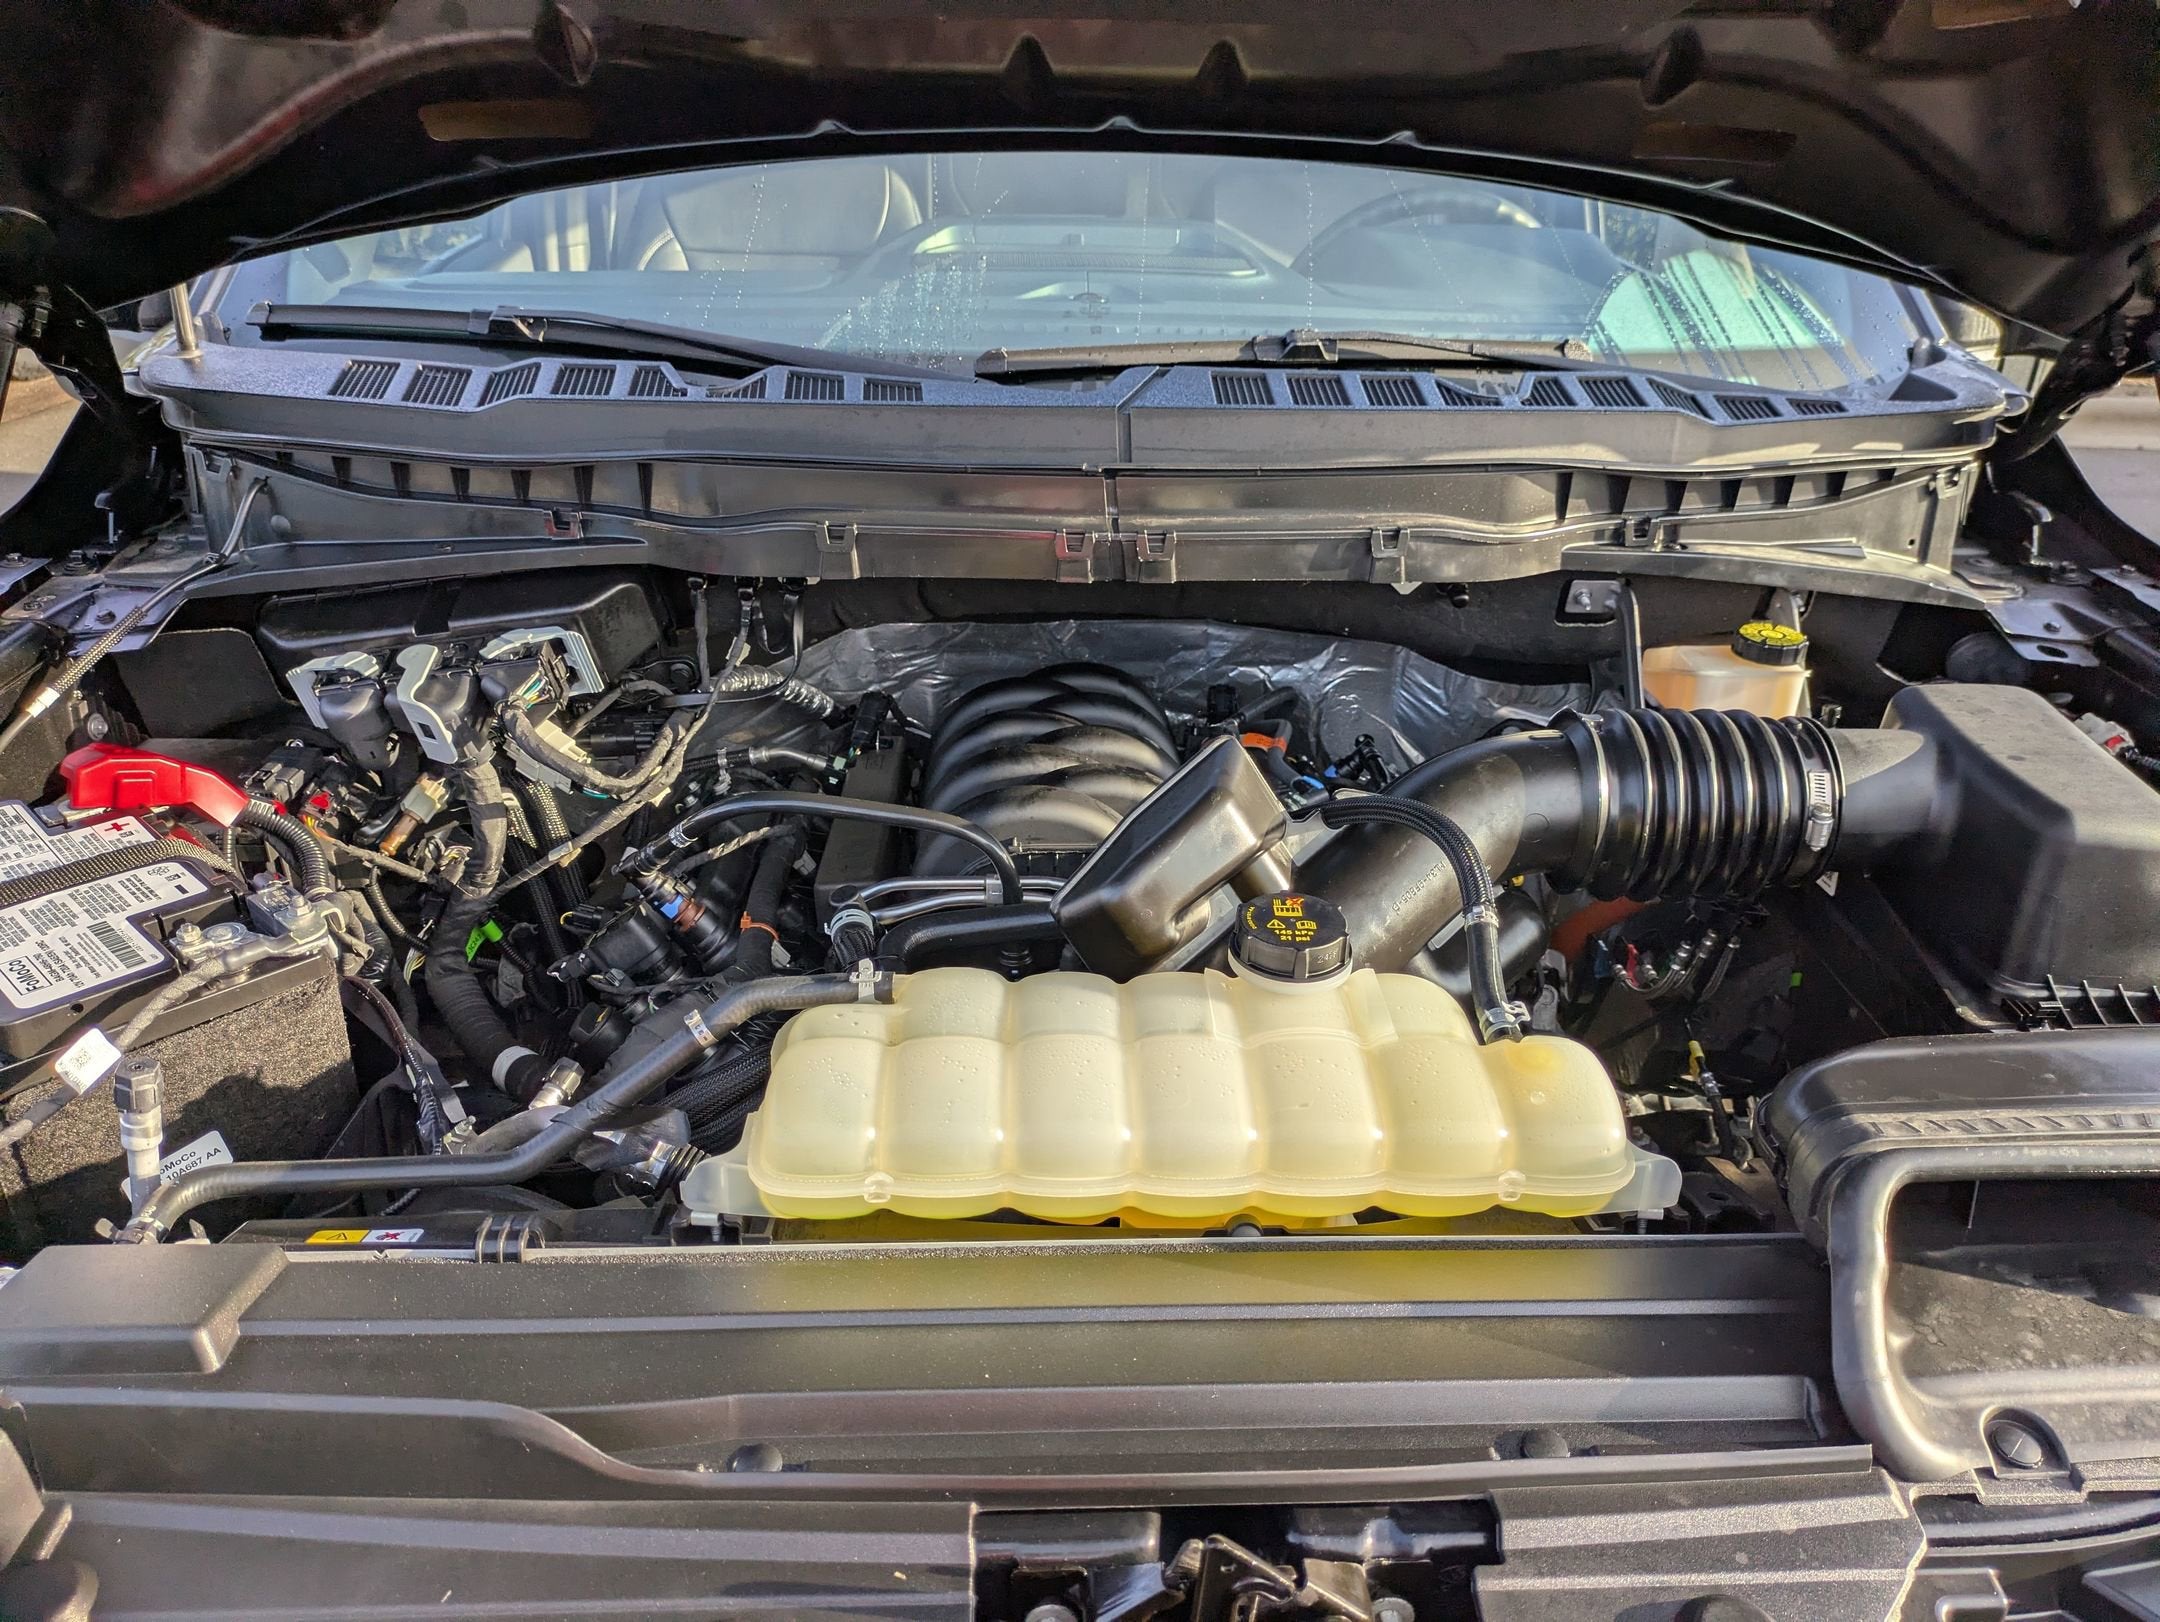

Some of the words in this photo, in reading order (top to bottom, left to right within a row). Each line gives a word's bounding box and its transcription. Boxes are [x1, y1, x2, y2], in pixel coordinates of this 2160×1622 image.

[9, 960, 44, 991] FoMoCo
[160, 1151, 196, 1174] oMoCo
[166, 1157, 202, 1180] 10A687
[206, 1147, 221, 1160] AA
